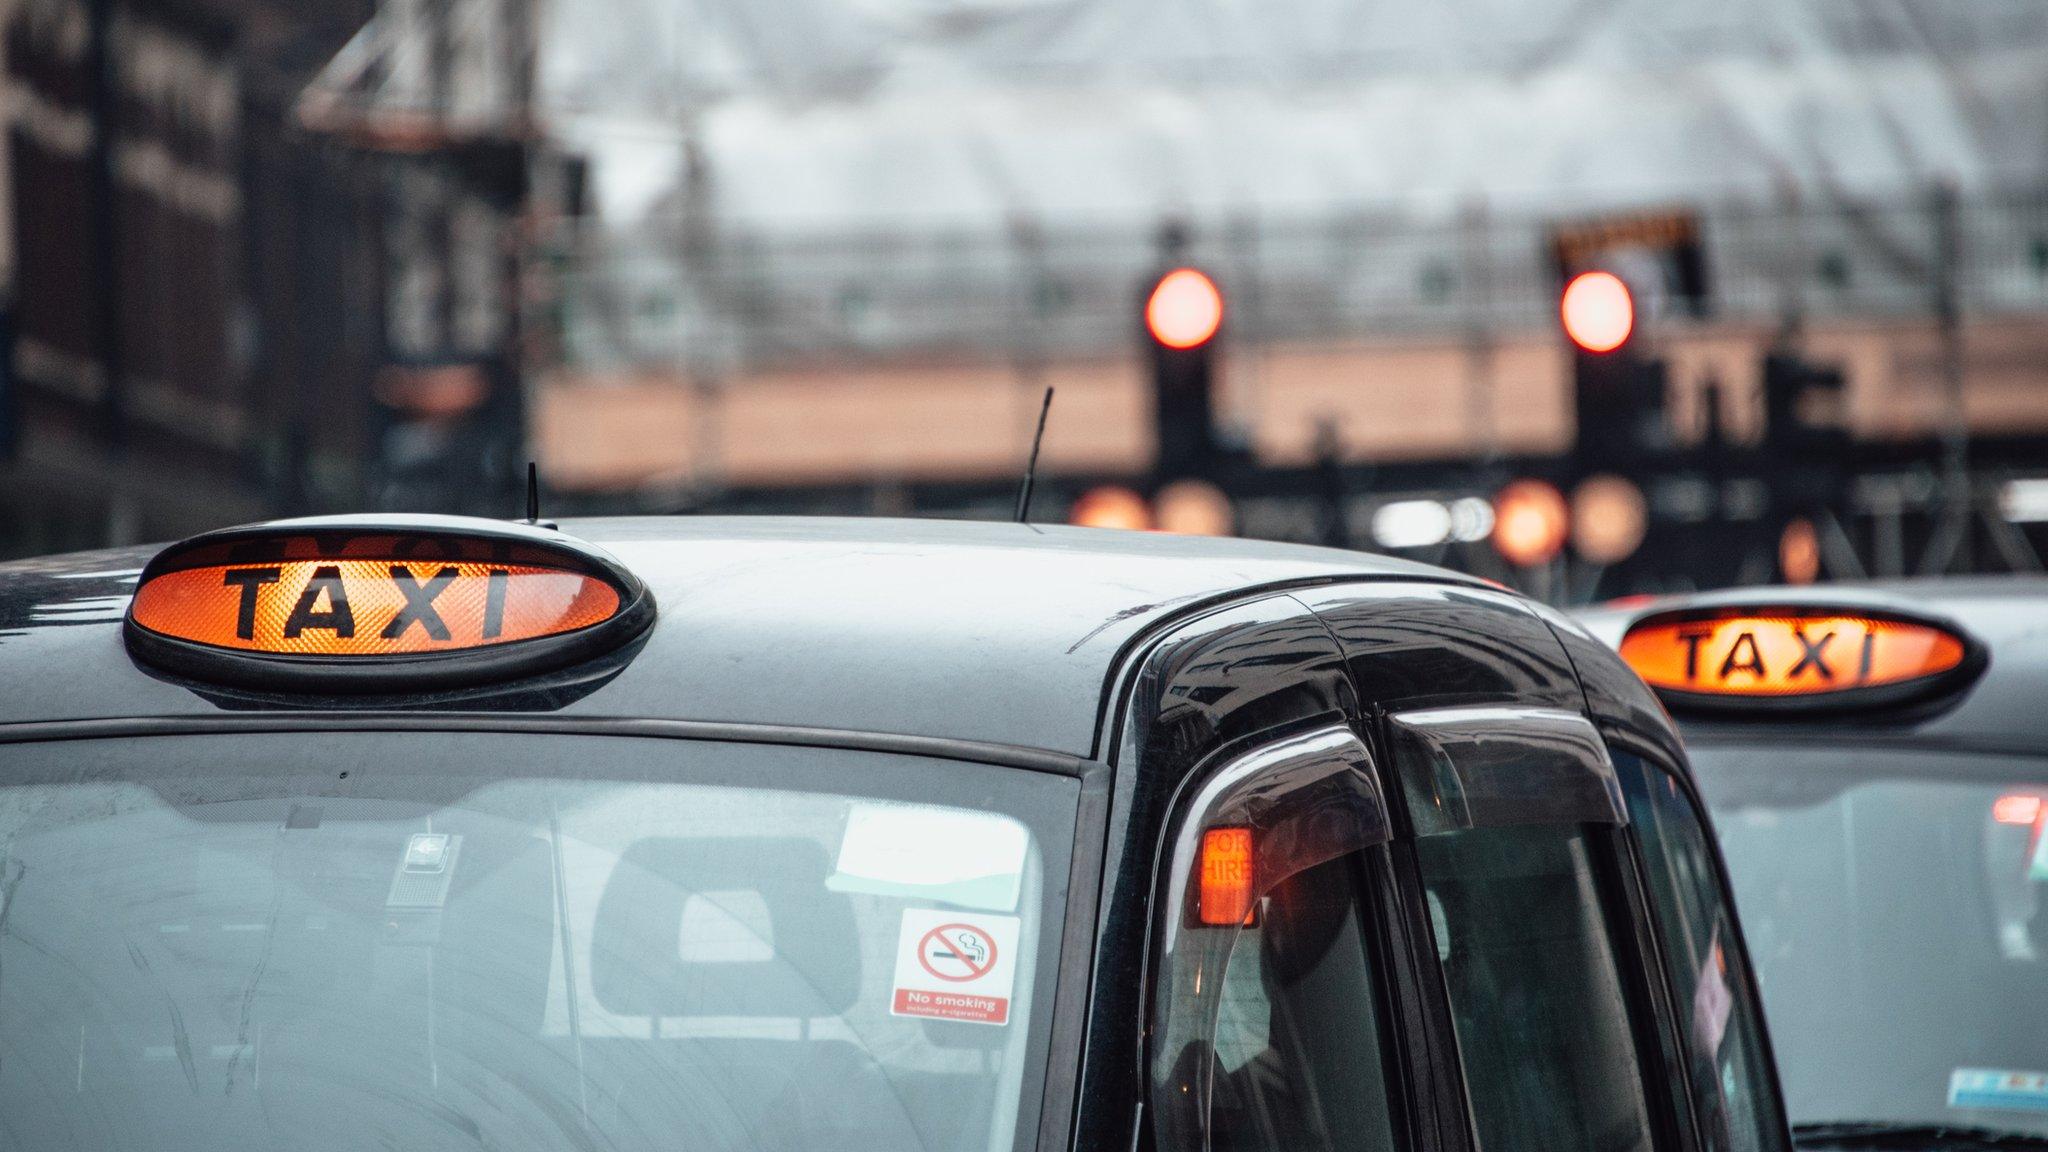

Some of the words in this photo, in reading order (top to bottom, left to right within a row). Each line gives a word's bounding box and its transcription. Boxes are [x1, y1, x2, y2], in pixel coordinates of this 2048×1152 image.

[224, 565, 509, 641] TAXI
[1677, 629, 1874, 681] TAXI
[1204, 832, 1251, 854] FOR
[1203, 858, 1252, 882] HIRE
[906, 1005, 940, 1015] including
[908, 992, 930, 1004] No
[935, 995, 996, 1012] smoking
